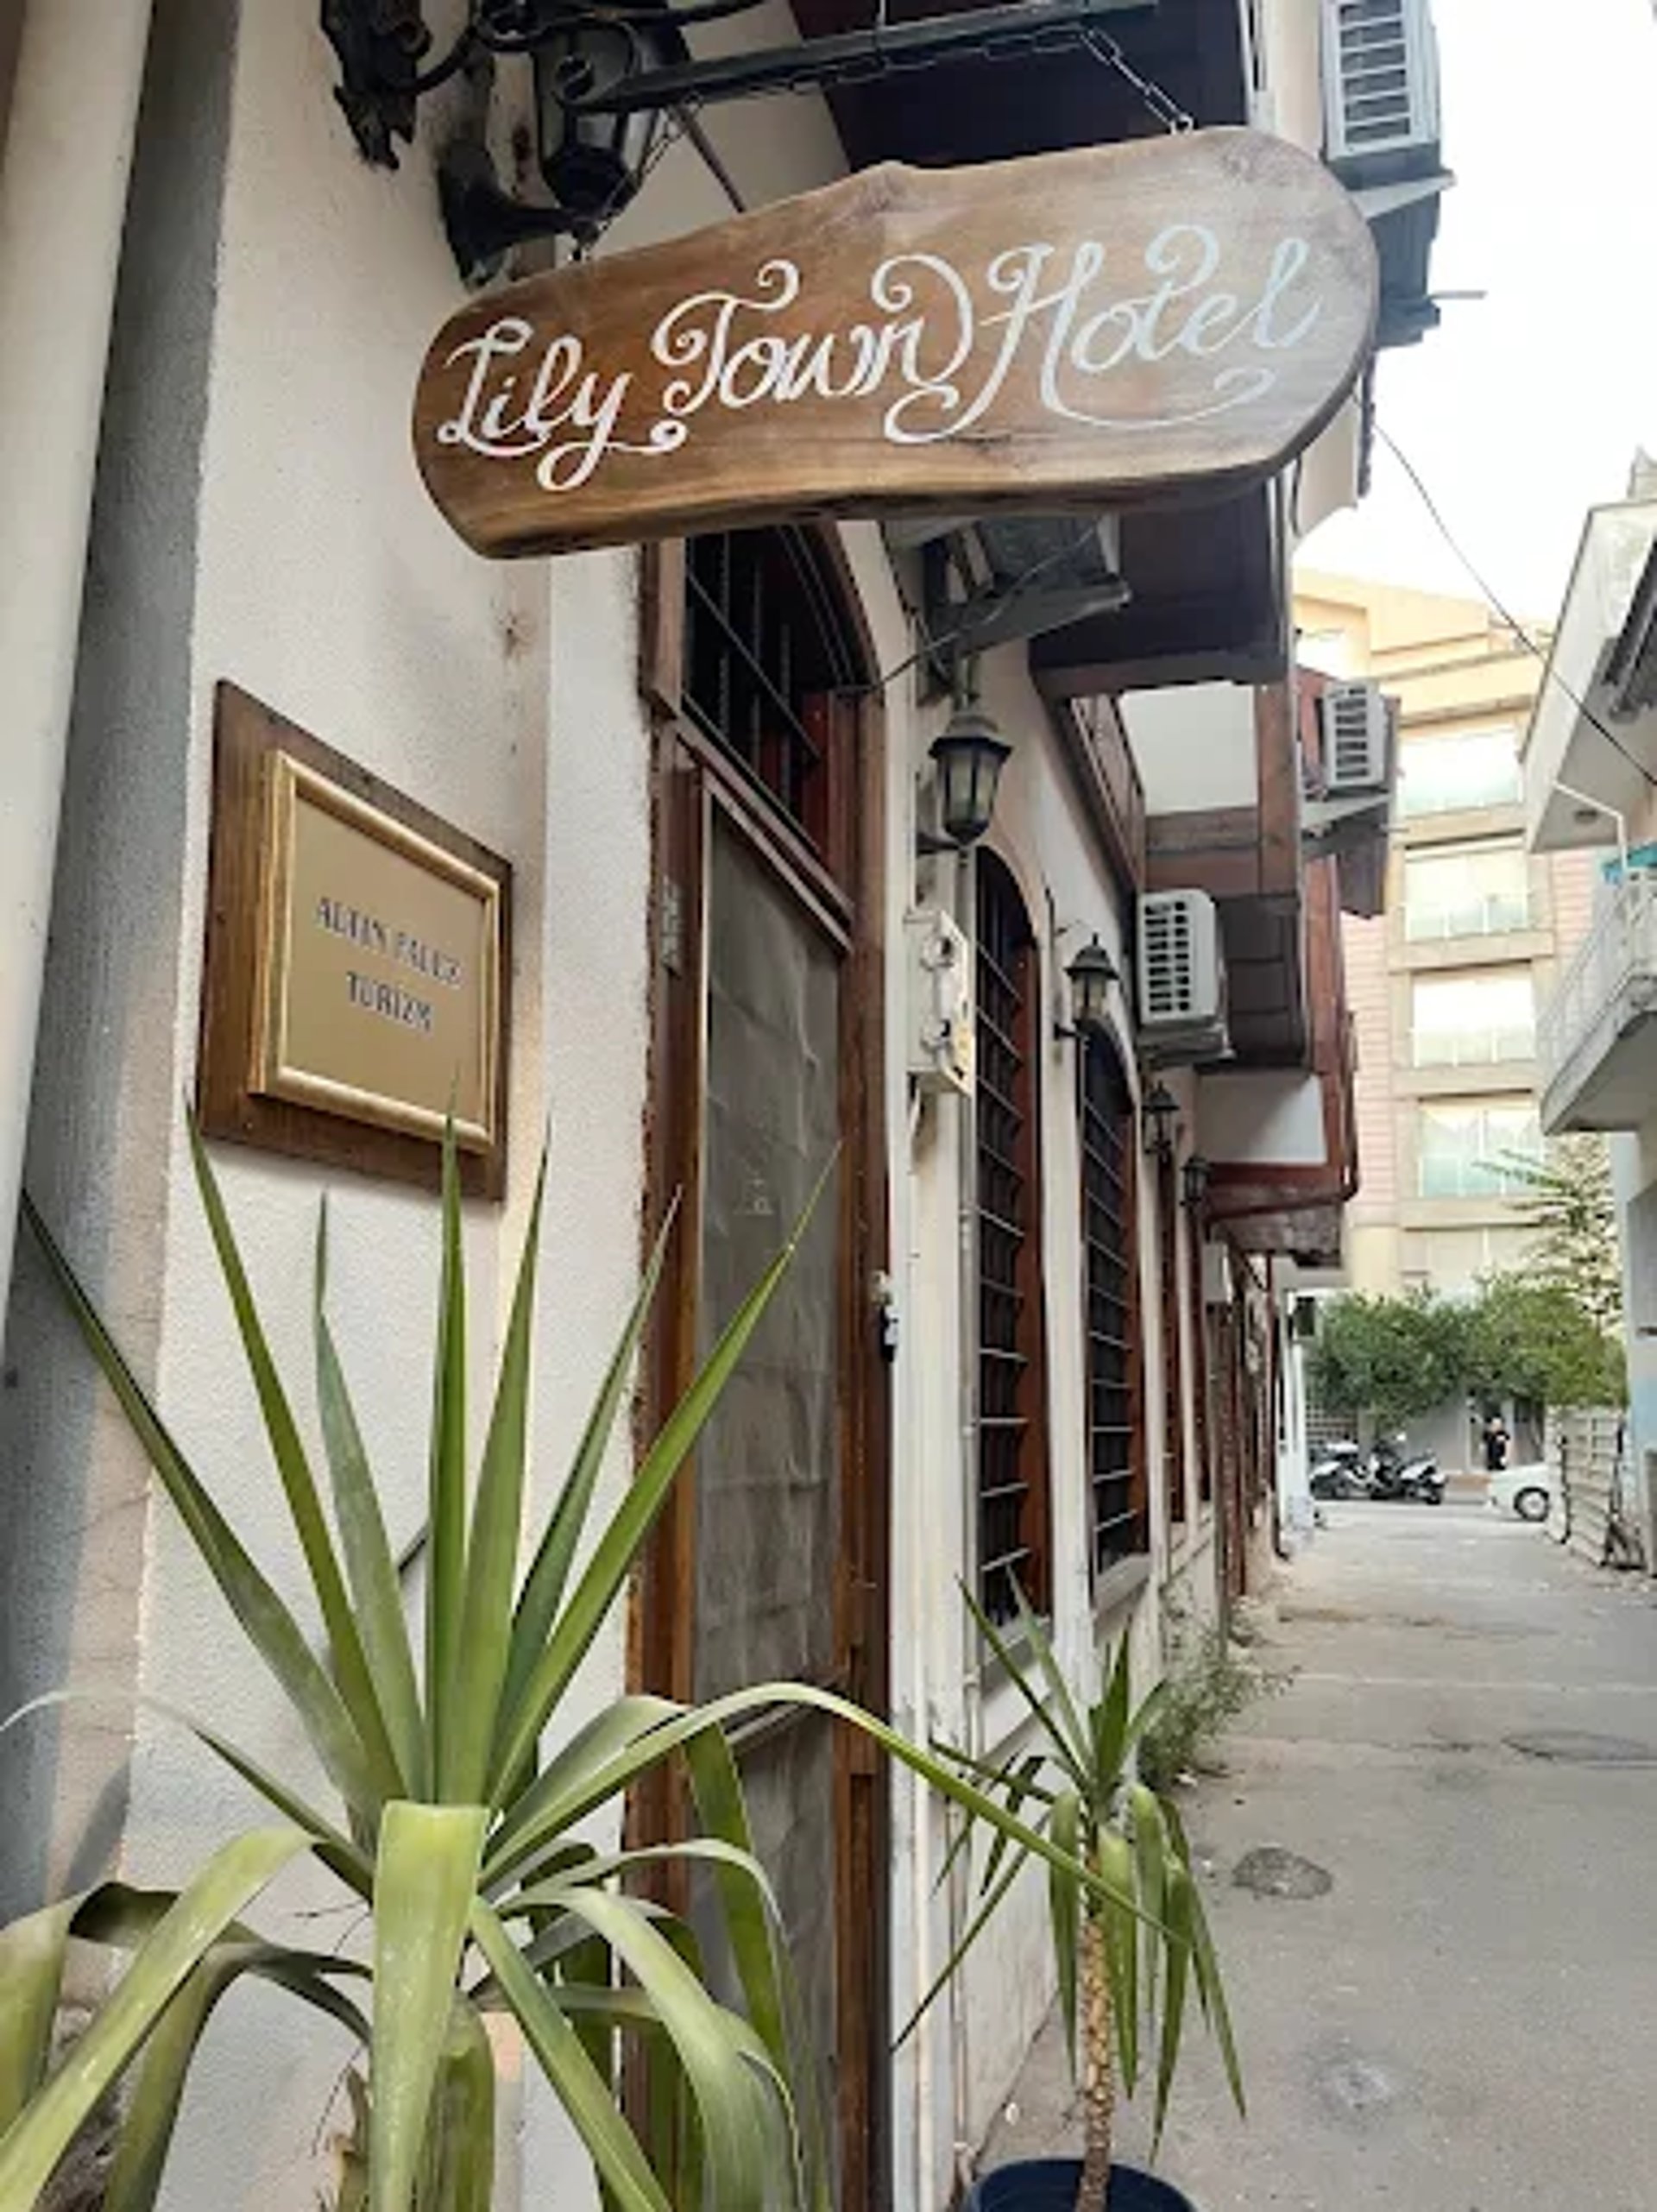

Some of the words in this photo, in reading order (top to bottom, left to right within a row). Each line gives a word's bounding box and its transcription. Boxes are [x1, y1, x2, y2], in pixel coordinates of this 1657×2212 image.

[436, 319, 687, 492] Lily
[652, 255, 975, 414] Town
[884, 224, 1325, 444] Hotel
